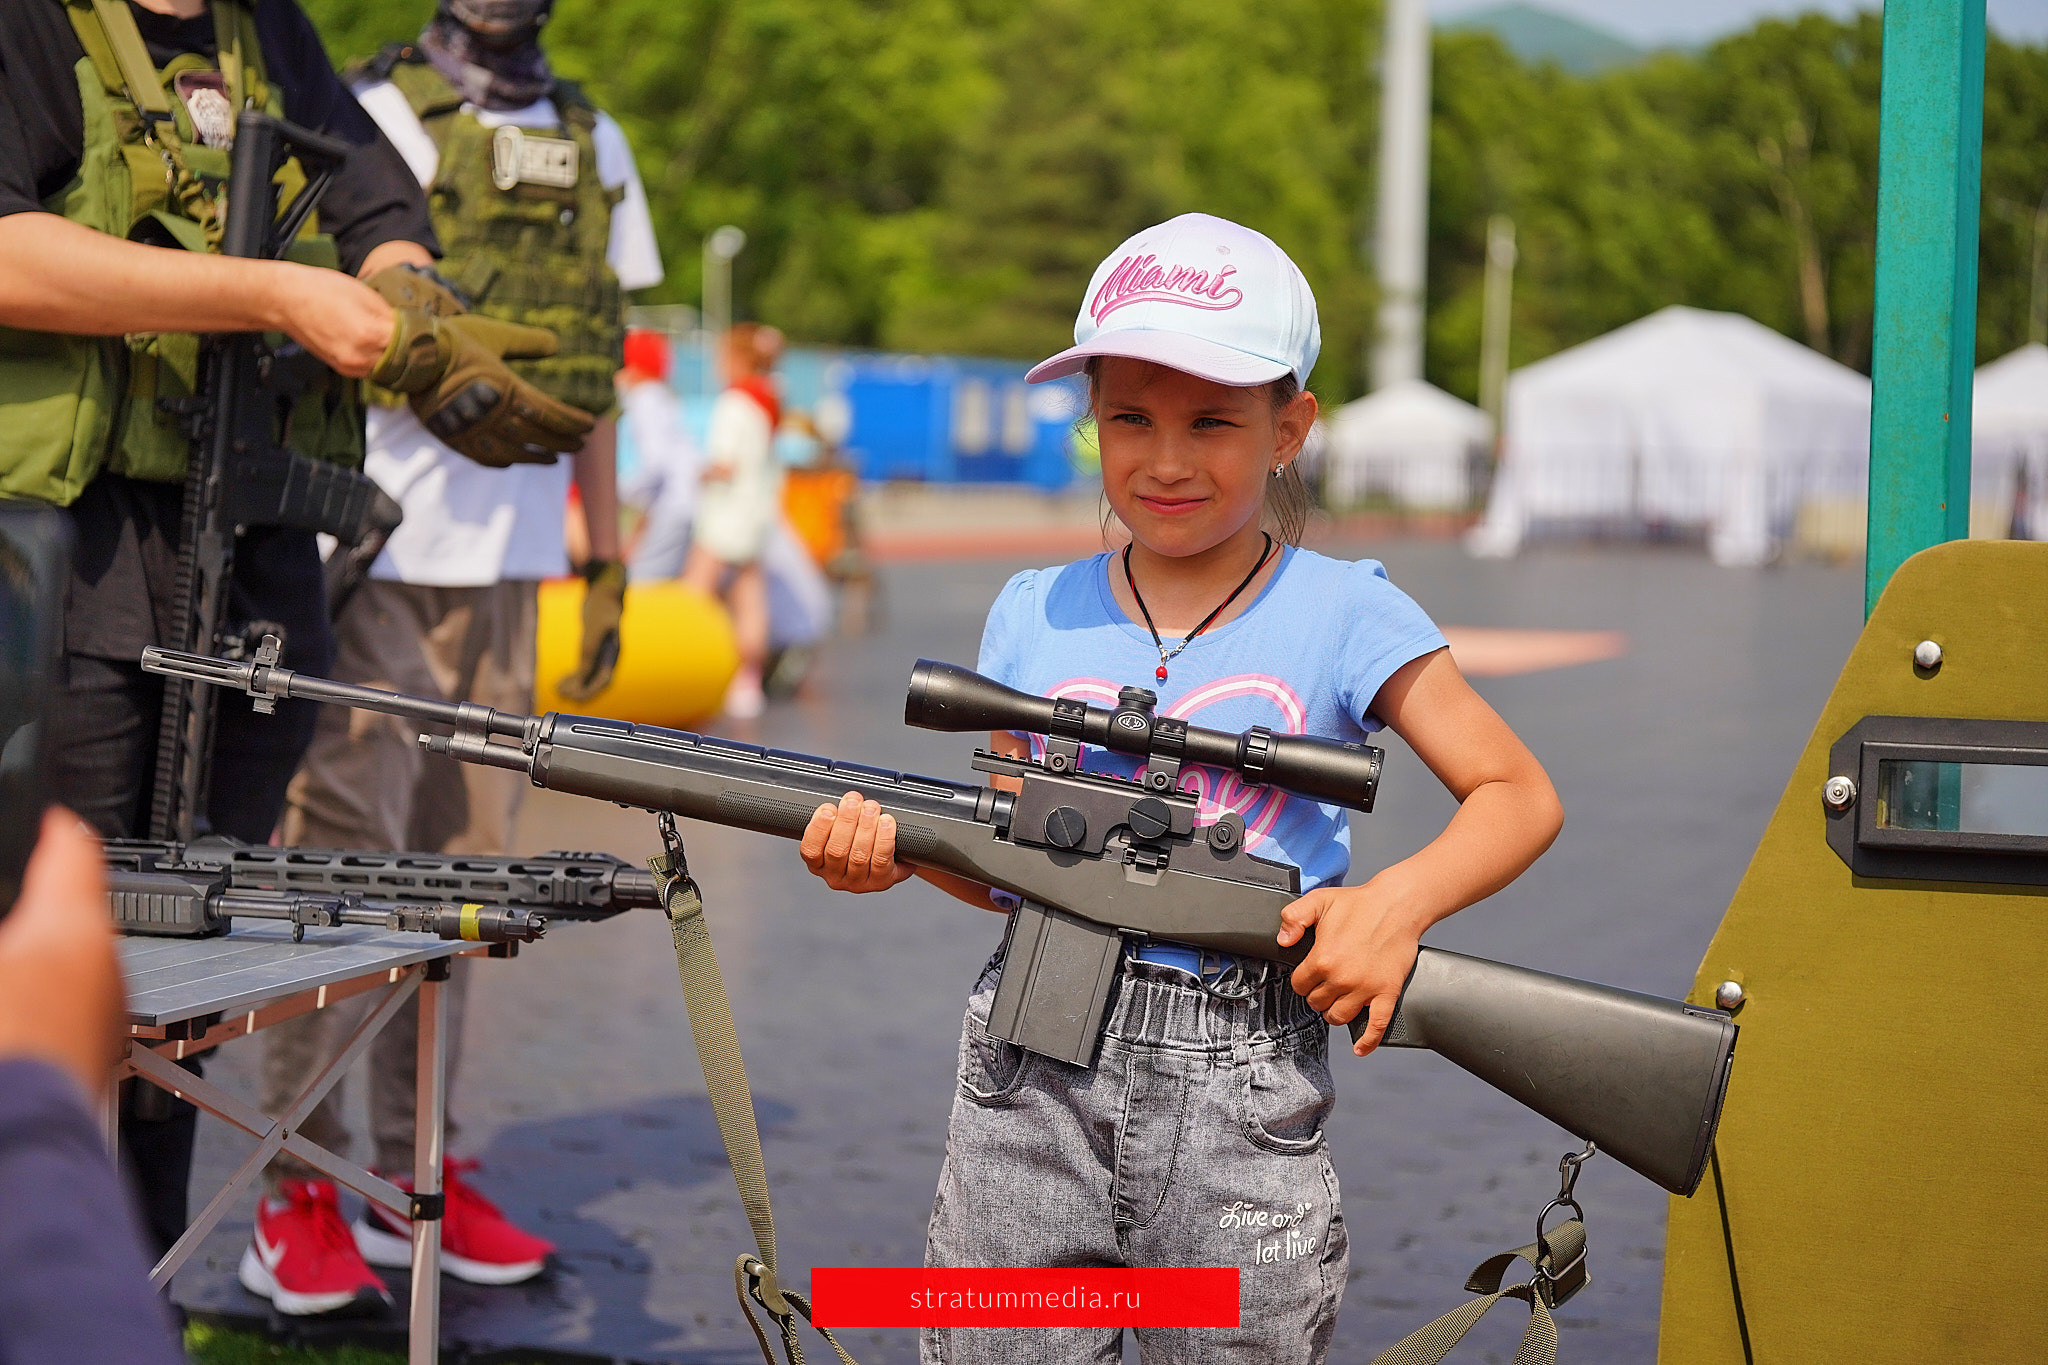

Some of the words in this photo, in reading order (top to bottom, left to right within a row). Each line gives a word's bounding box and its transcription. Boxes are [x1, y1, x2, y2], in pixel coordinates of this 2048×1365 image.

[1090, 254, 1240, 318] Miami
[1219, 1201, 1268, 1229] Live
[1272, 1203, 1305, 1229] and
[1255, 1238, 1281, 1265] let
[1286, 1230, 1317, 1260] live
